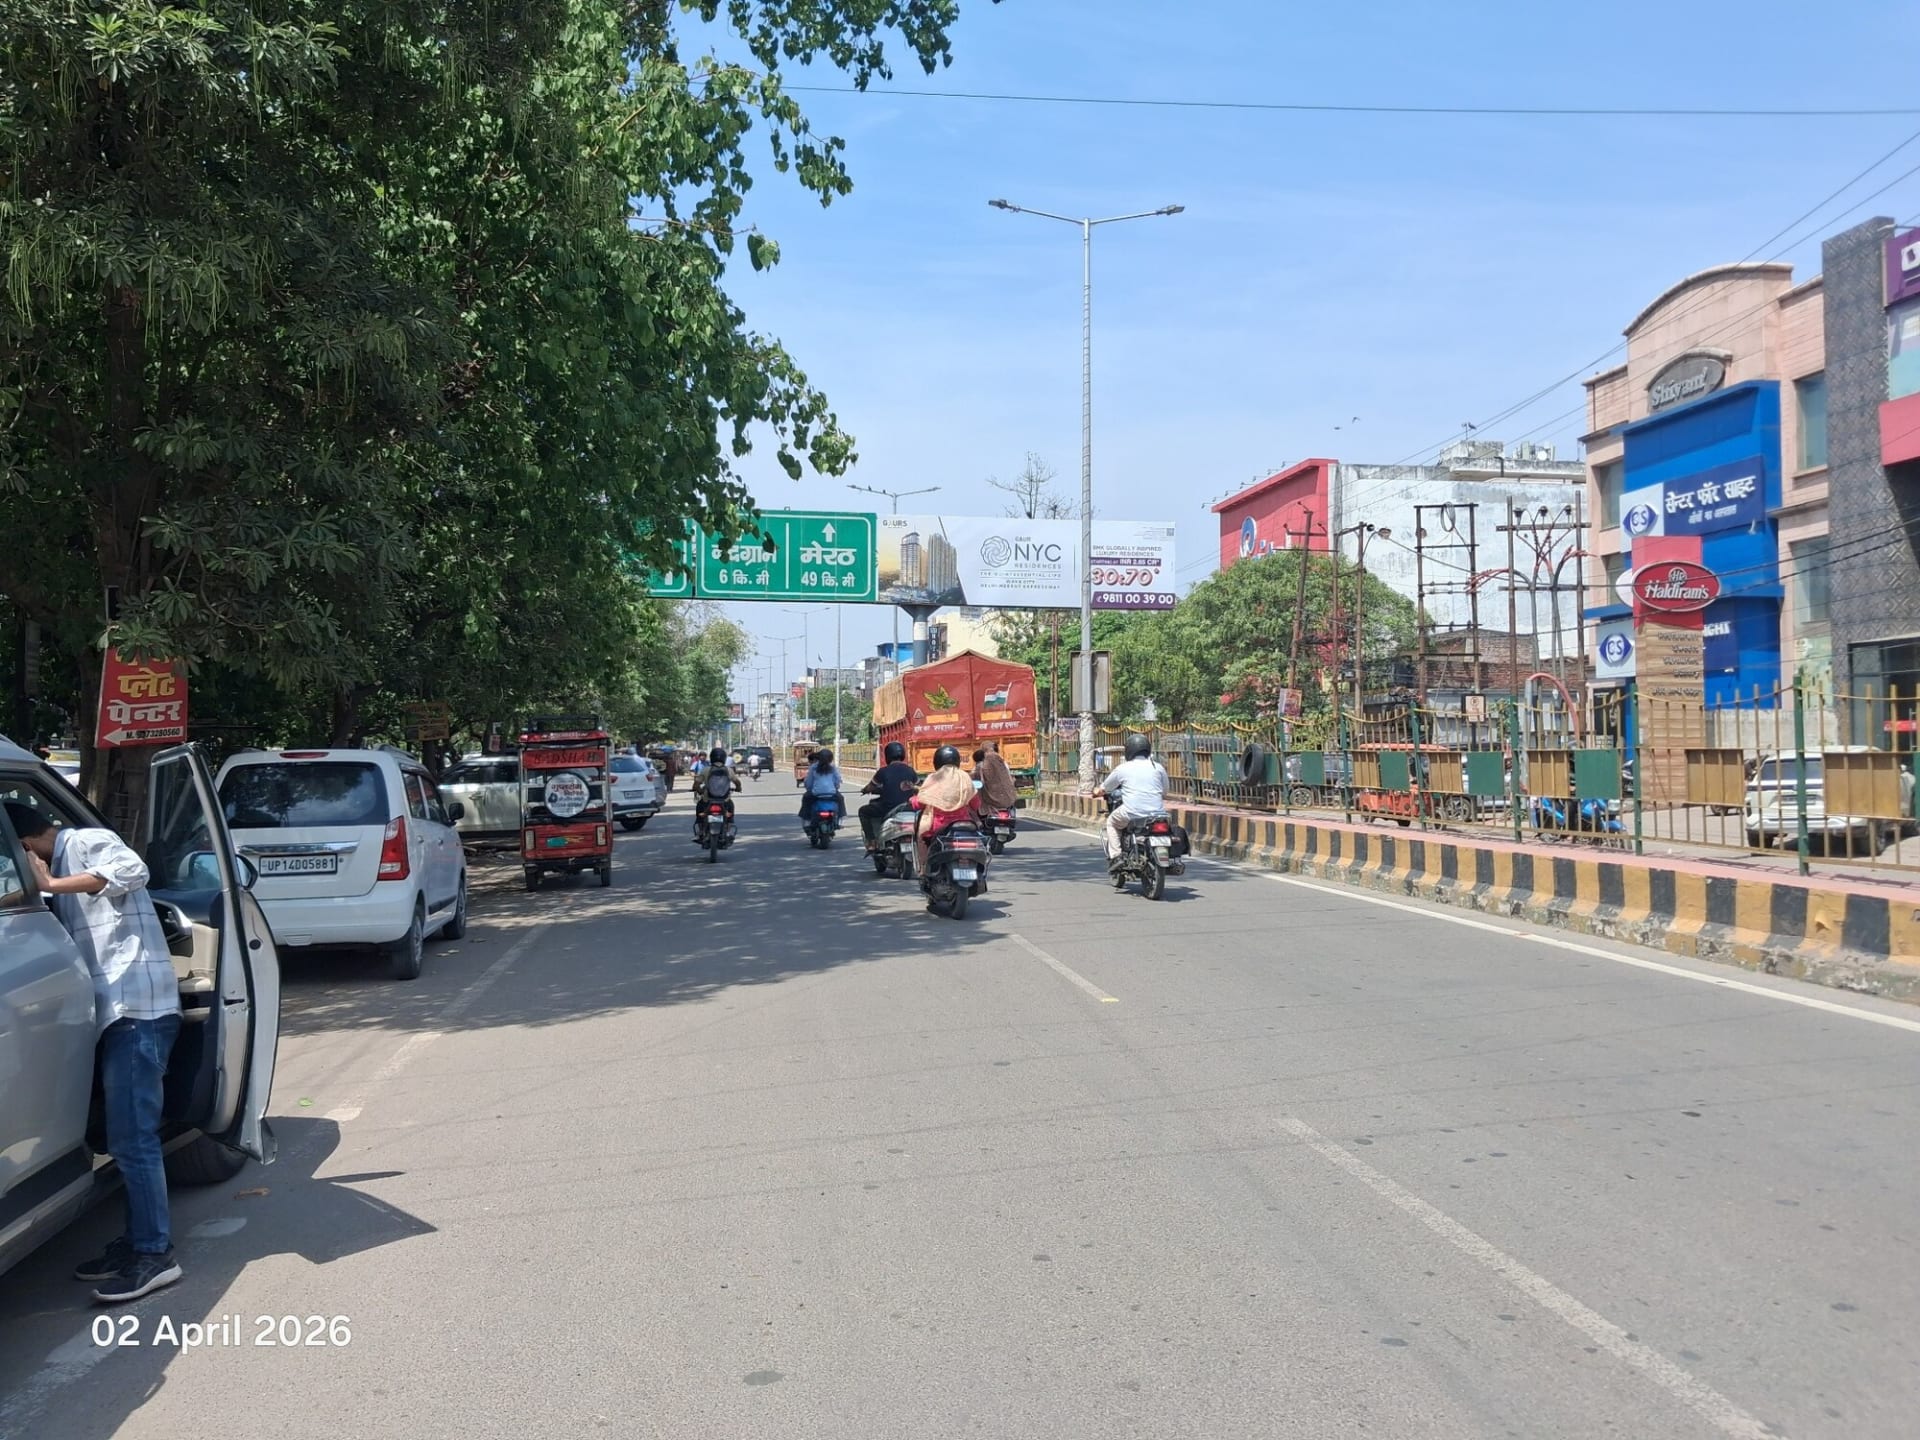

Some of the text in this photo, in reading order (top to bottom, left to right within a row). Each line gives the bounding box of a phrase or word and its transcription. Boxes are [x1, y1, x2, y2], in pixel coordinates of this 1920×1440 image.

[1697, 481, 1721, 505] फॉर
[1723, 475, 1756, 499] साइट
[800, 540, 857, 566] मेरठ
[1014, 543, 1062, 562] NYC
[719, 569, 728, 584] 6
[756, 569, 770, 585] मी
[801, 571, 818, 587] 49
[842, 572, 856, 588] मी
[1102, 593, 1173, 604] 9811 00 39 00
[1645, 580, 1709, 599] Haldiram's
[117, 667, 176, 698] प्लेट
[106, 699, 183, 725] पेन्टर
